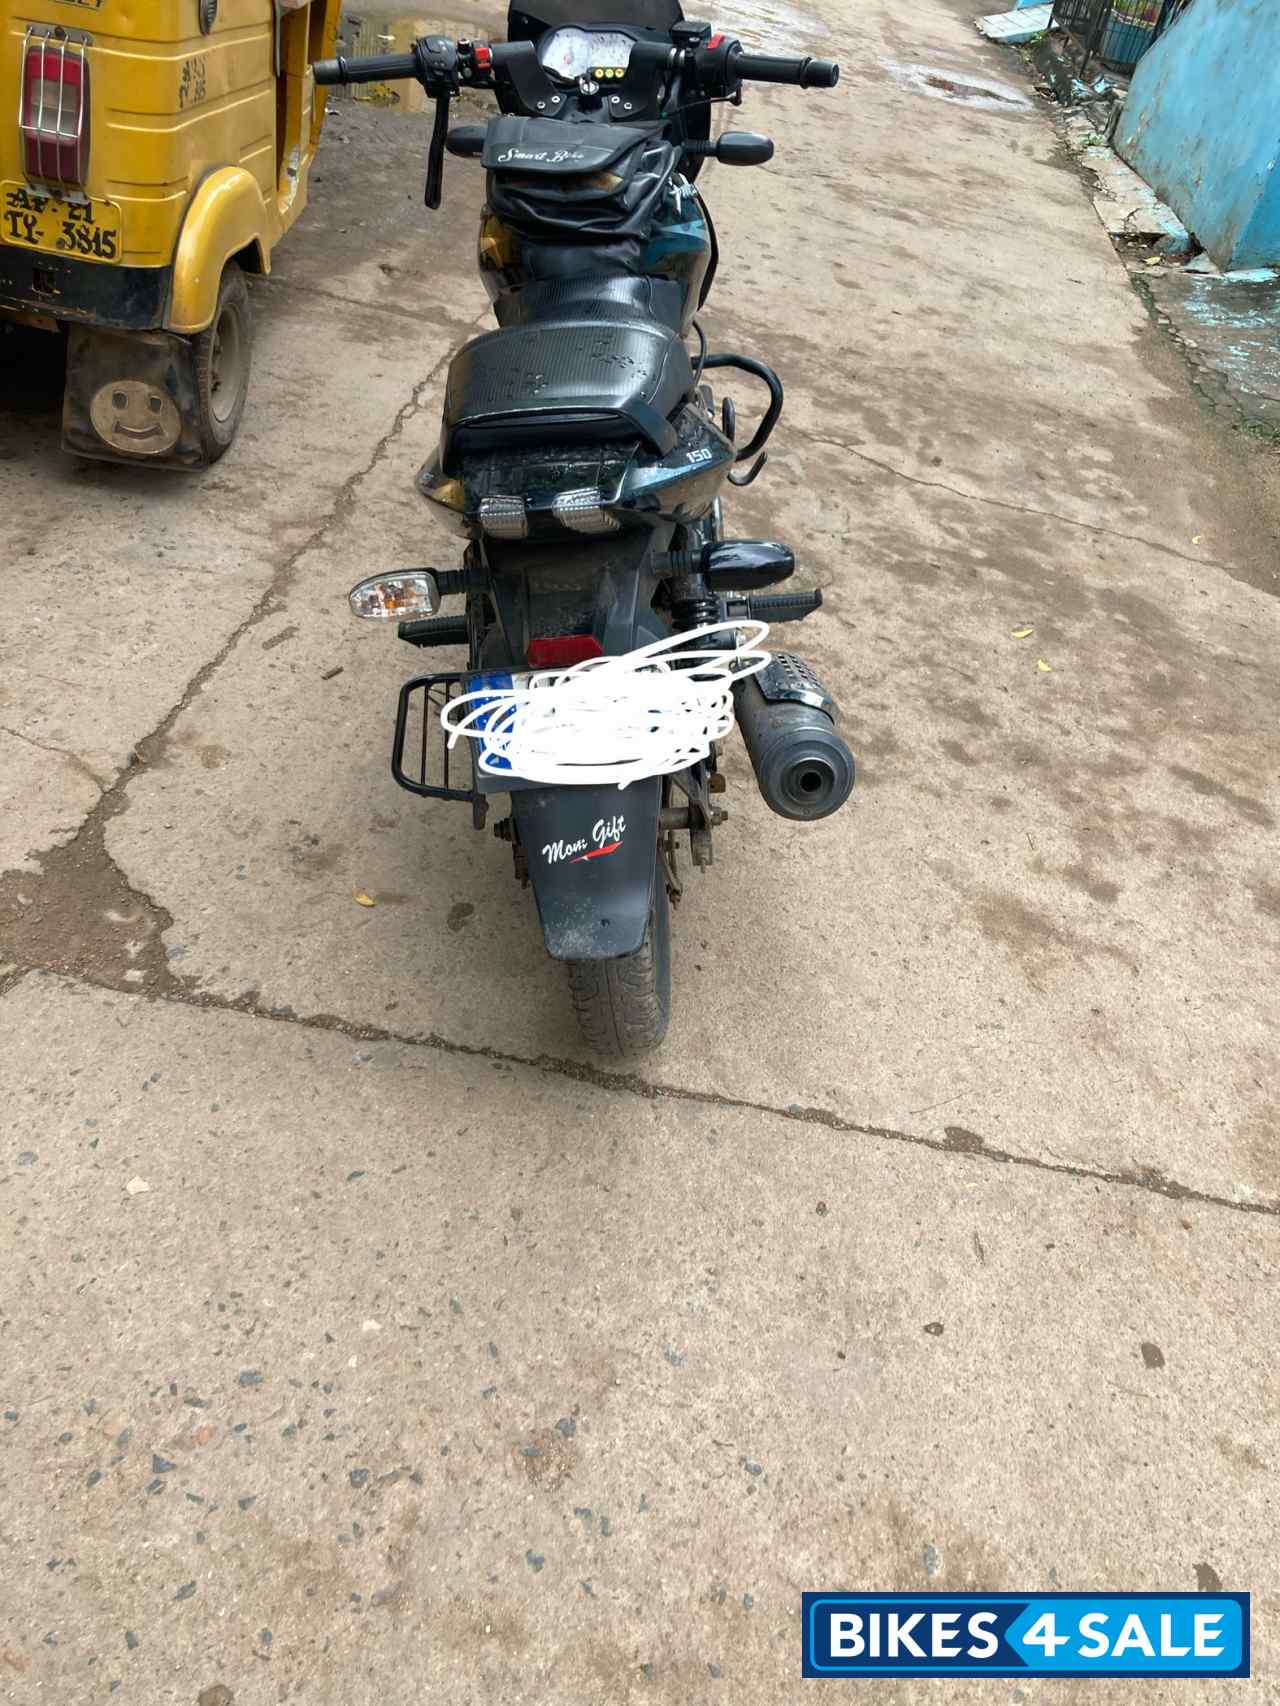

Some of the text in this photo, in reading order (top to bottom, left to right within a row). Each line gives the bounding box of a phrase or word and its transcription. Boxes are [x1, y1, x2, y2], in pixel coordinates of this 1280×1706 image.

[497, 147, 547, 162] Smart
[686, 448, 713, 463] 150
[592, 815, 626, 848] Gift
